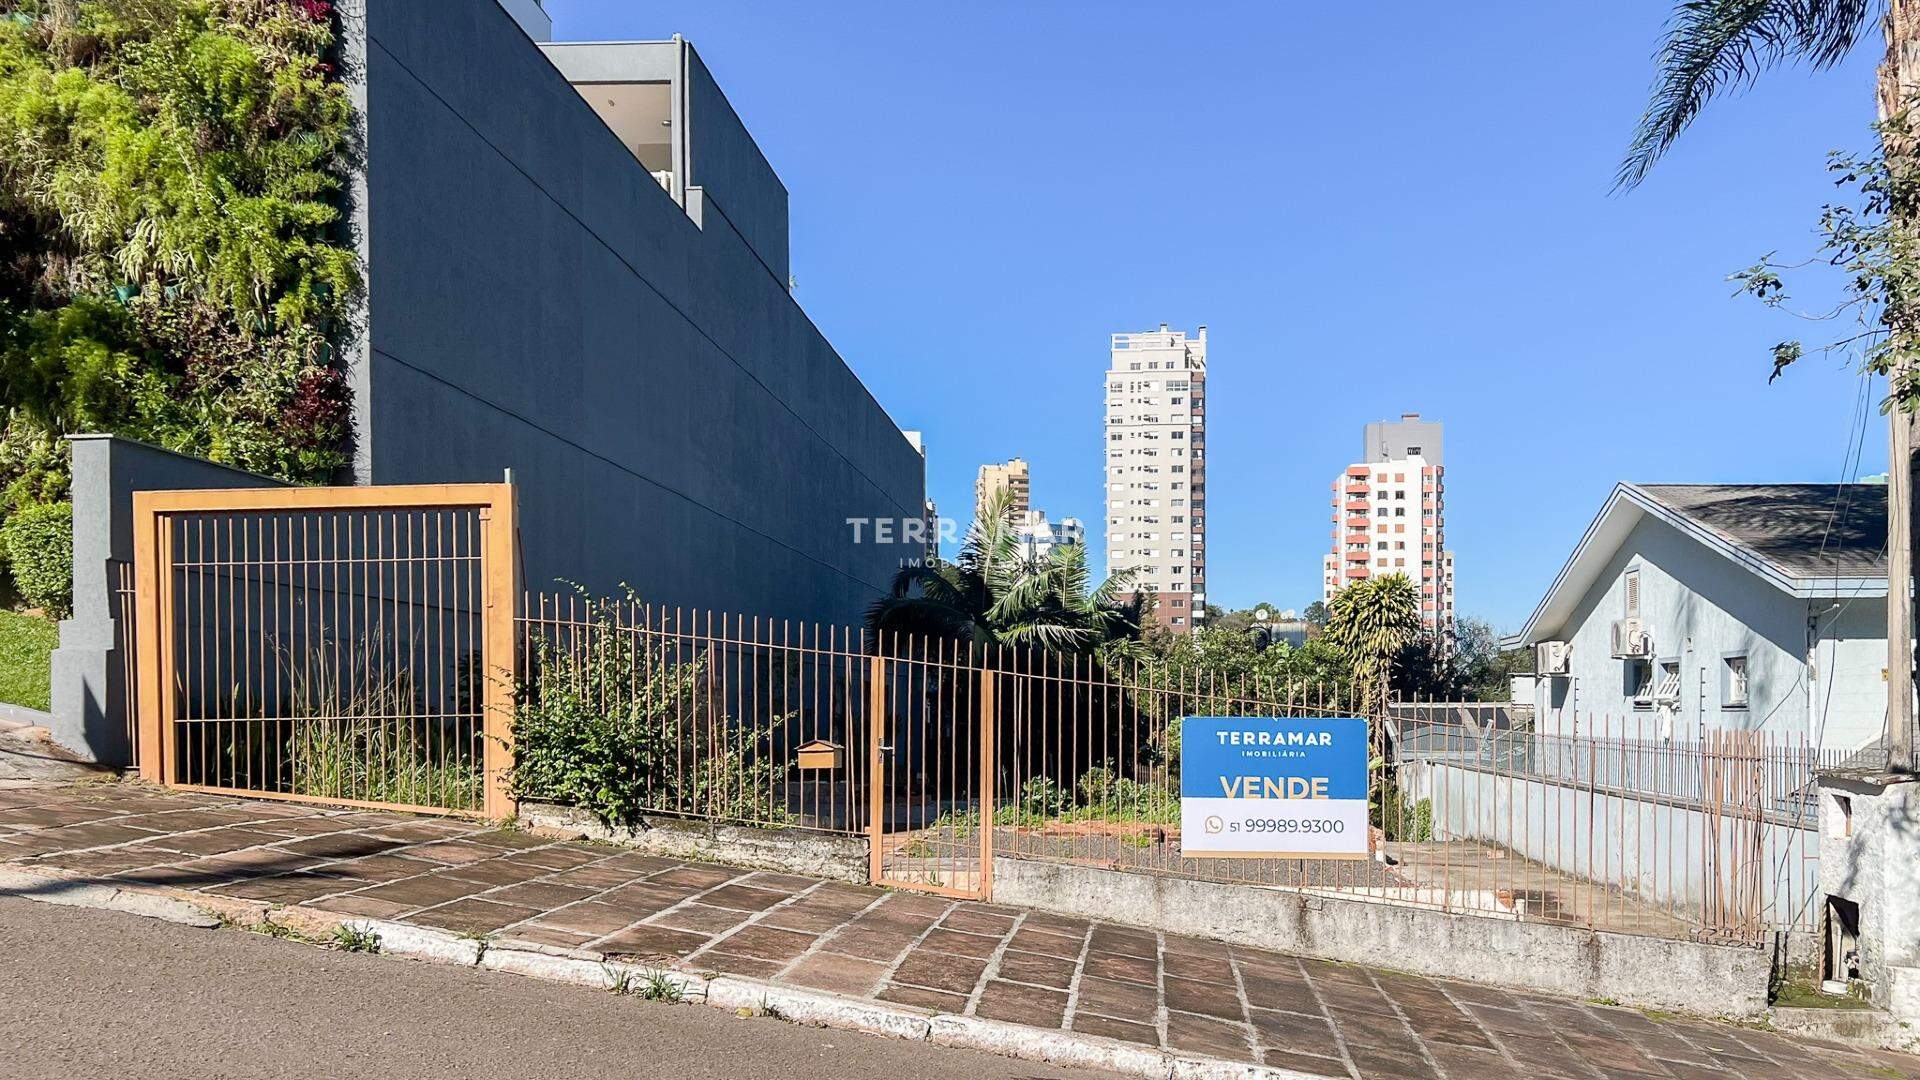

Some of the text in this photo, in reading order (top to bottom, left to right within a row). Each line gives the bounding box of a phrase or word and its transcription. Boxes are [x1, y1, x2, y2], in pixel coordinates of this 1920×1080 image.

[1217, 731, 1332, 746] TERRAMAR
[1242, 750, 1306, 758] IMOBILIÁRIA
[1219, 776, 1330, 799] VENDE
[1230, 819, 1344, 834] 51 99989.9300
